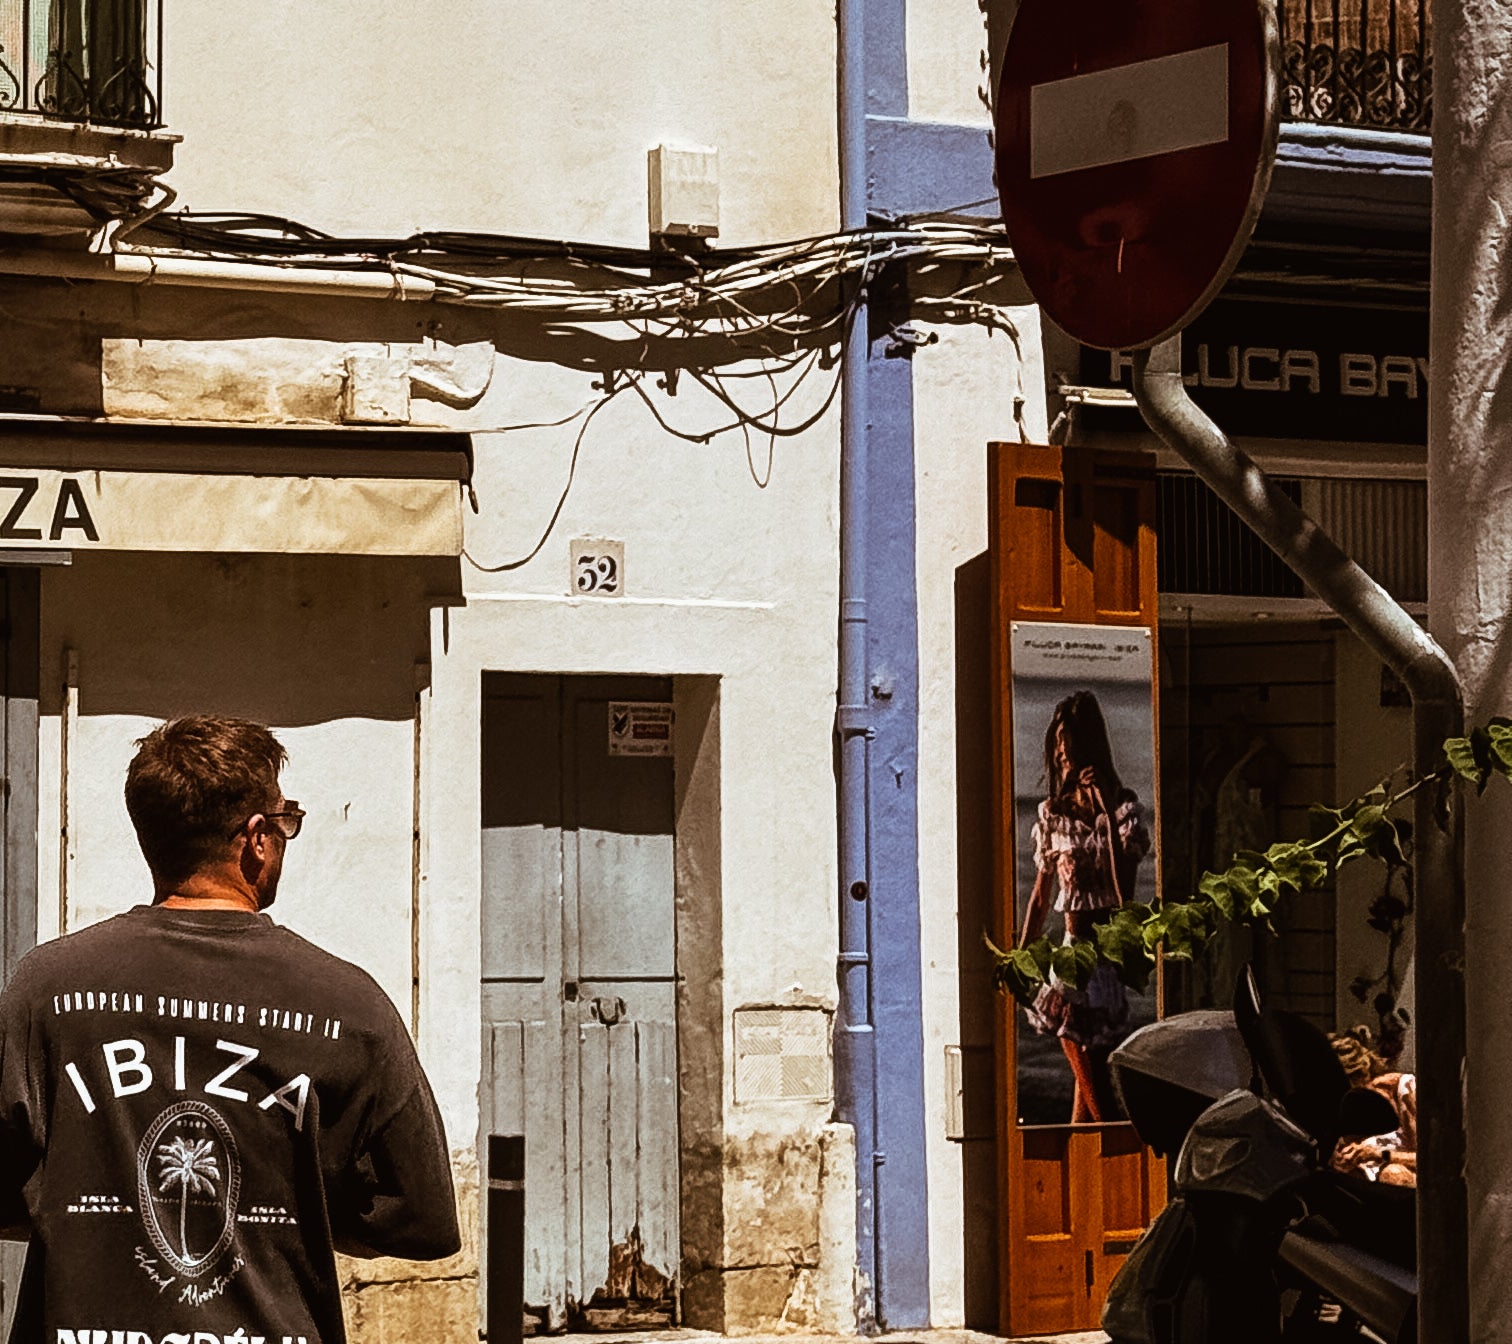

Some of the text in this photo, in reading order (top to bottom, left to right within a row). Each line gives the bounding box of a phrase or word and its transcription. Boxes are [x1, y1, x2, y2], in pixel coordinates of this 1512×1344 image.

[53, 990, 342, 1040] EUROPEAN SUMMERS START IN
[65, 1036, 313, 1131] IBIZA
